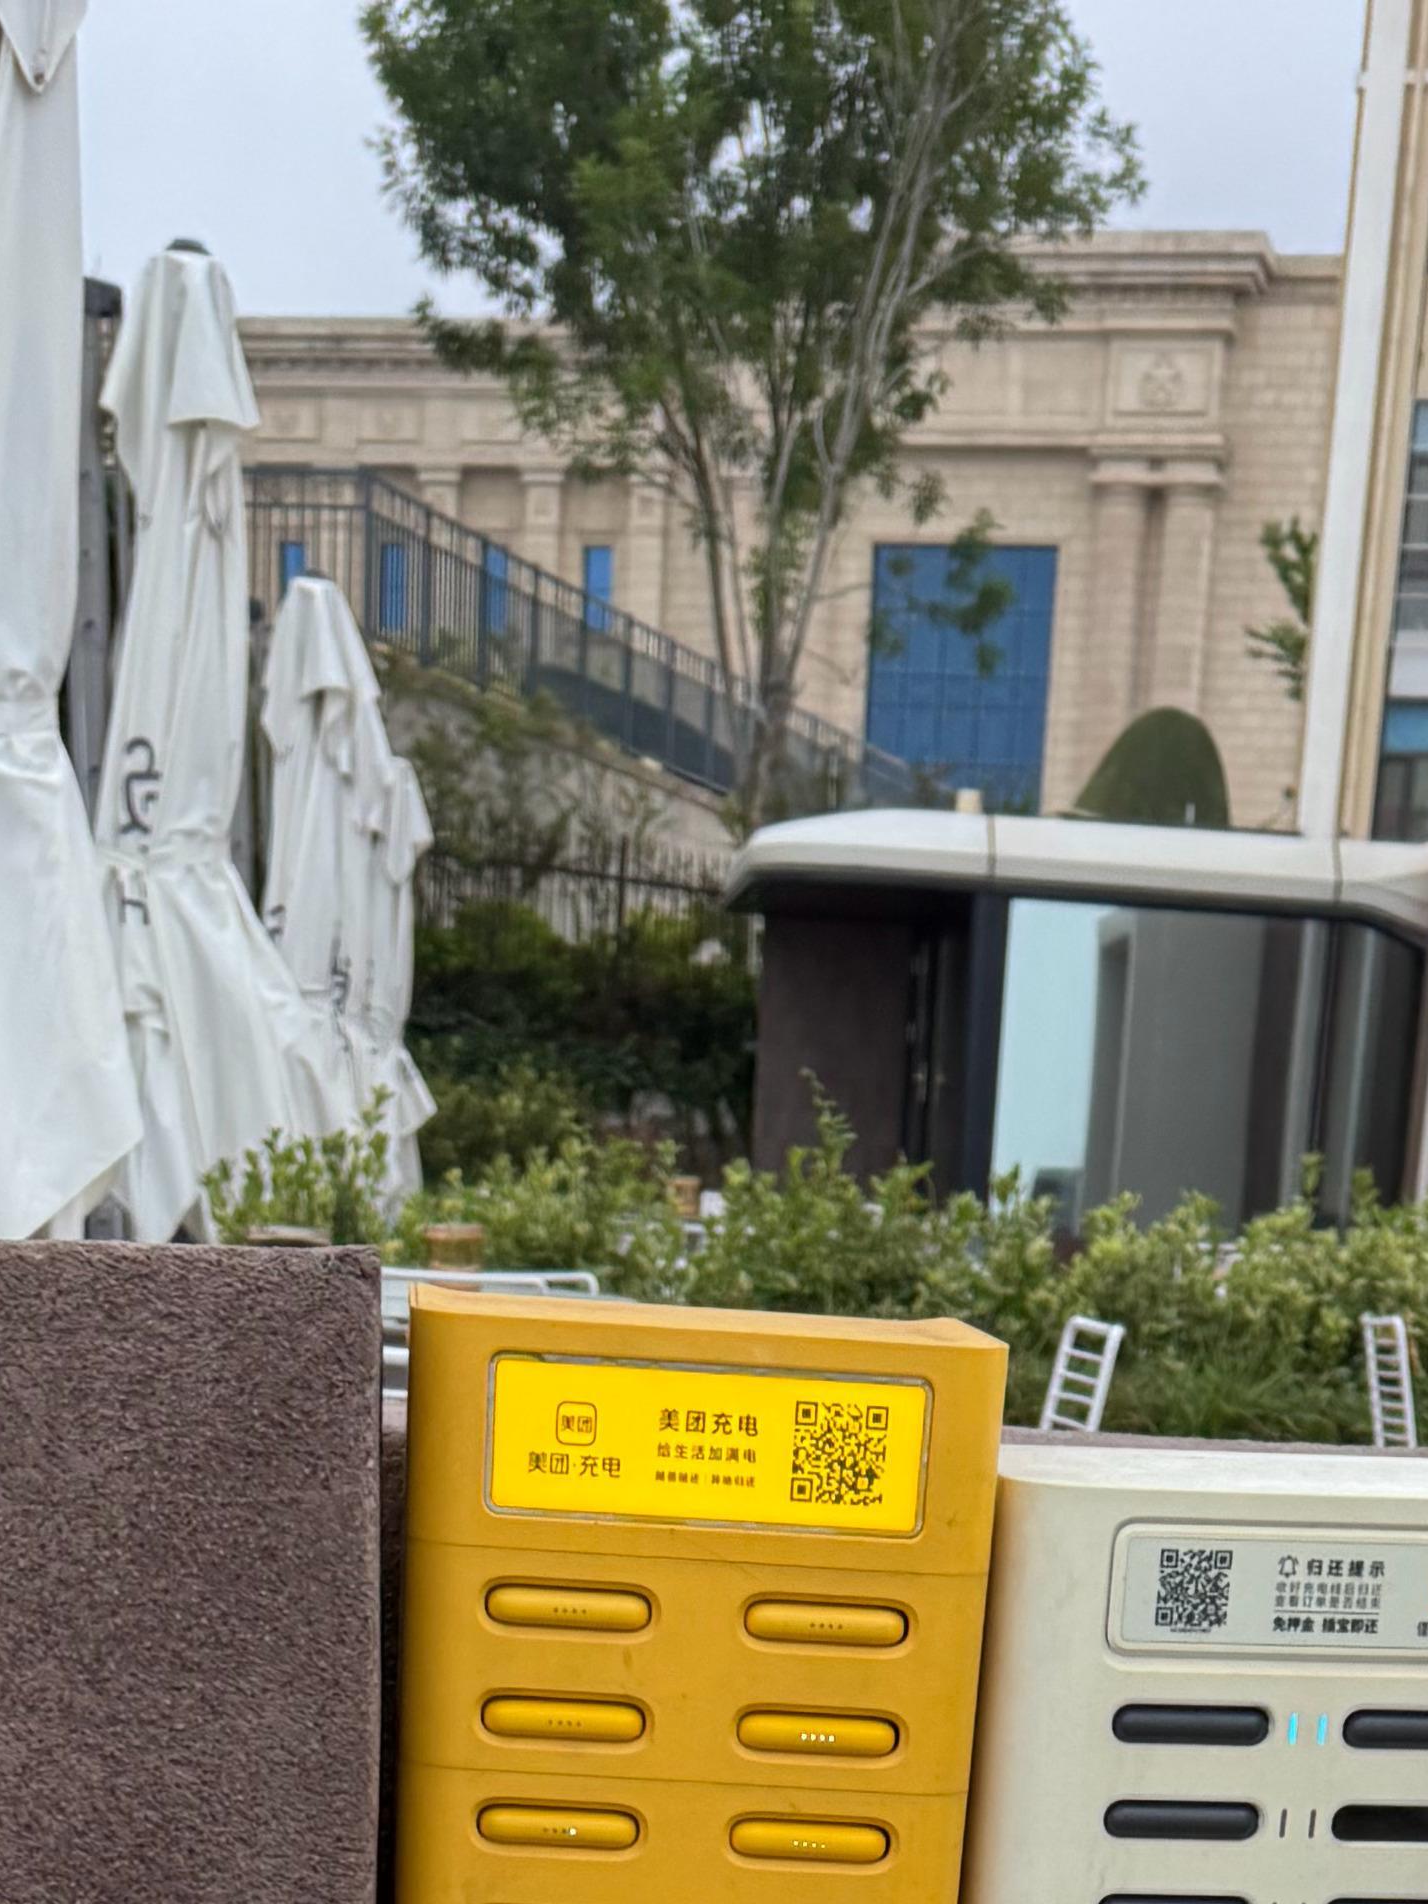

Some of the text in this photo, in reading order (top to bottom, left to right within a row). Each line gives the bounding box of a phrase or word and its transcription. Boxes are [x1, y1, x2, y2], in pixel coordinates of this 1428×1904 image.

[561, 1415, 593, 1434] 美团
[659, 1408, 759, 1437] 美团充电
[657, 1442, 757, 1464] 给生活加满电
[1307, 1558, 1385, 1579] 归还提示
[1273, 1616, 1315, 1633] 免押金
